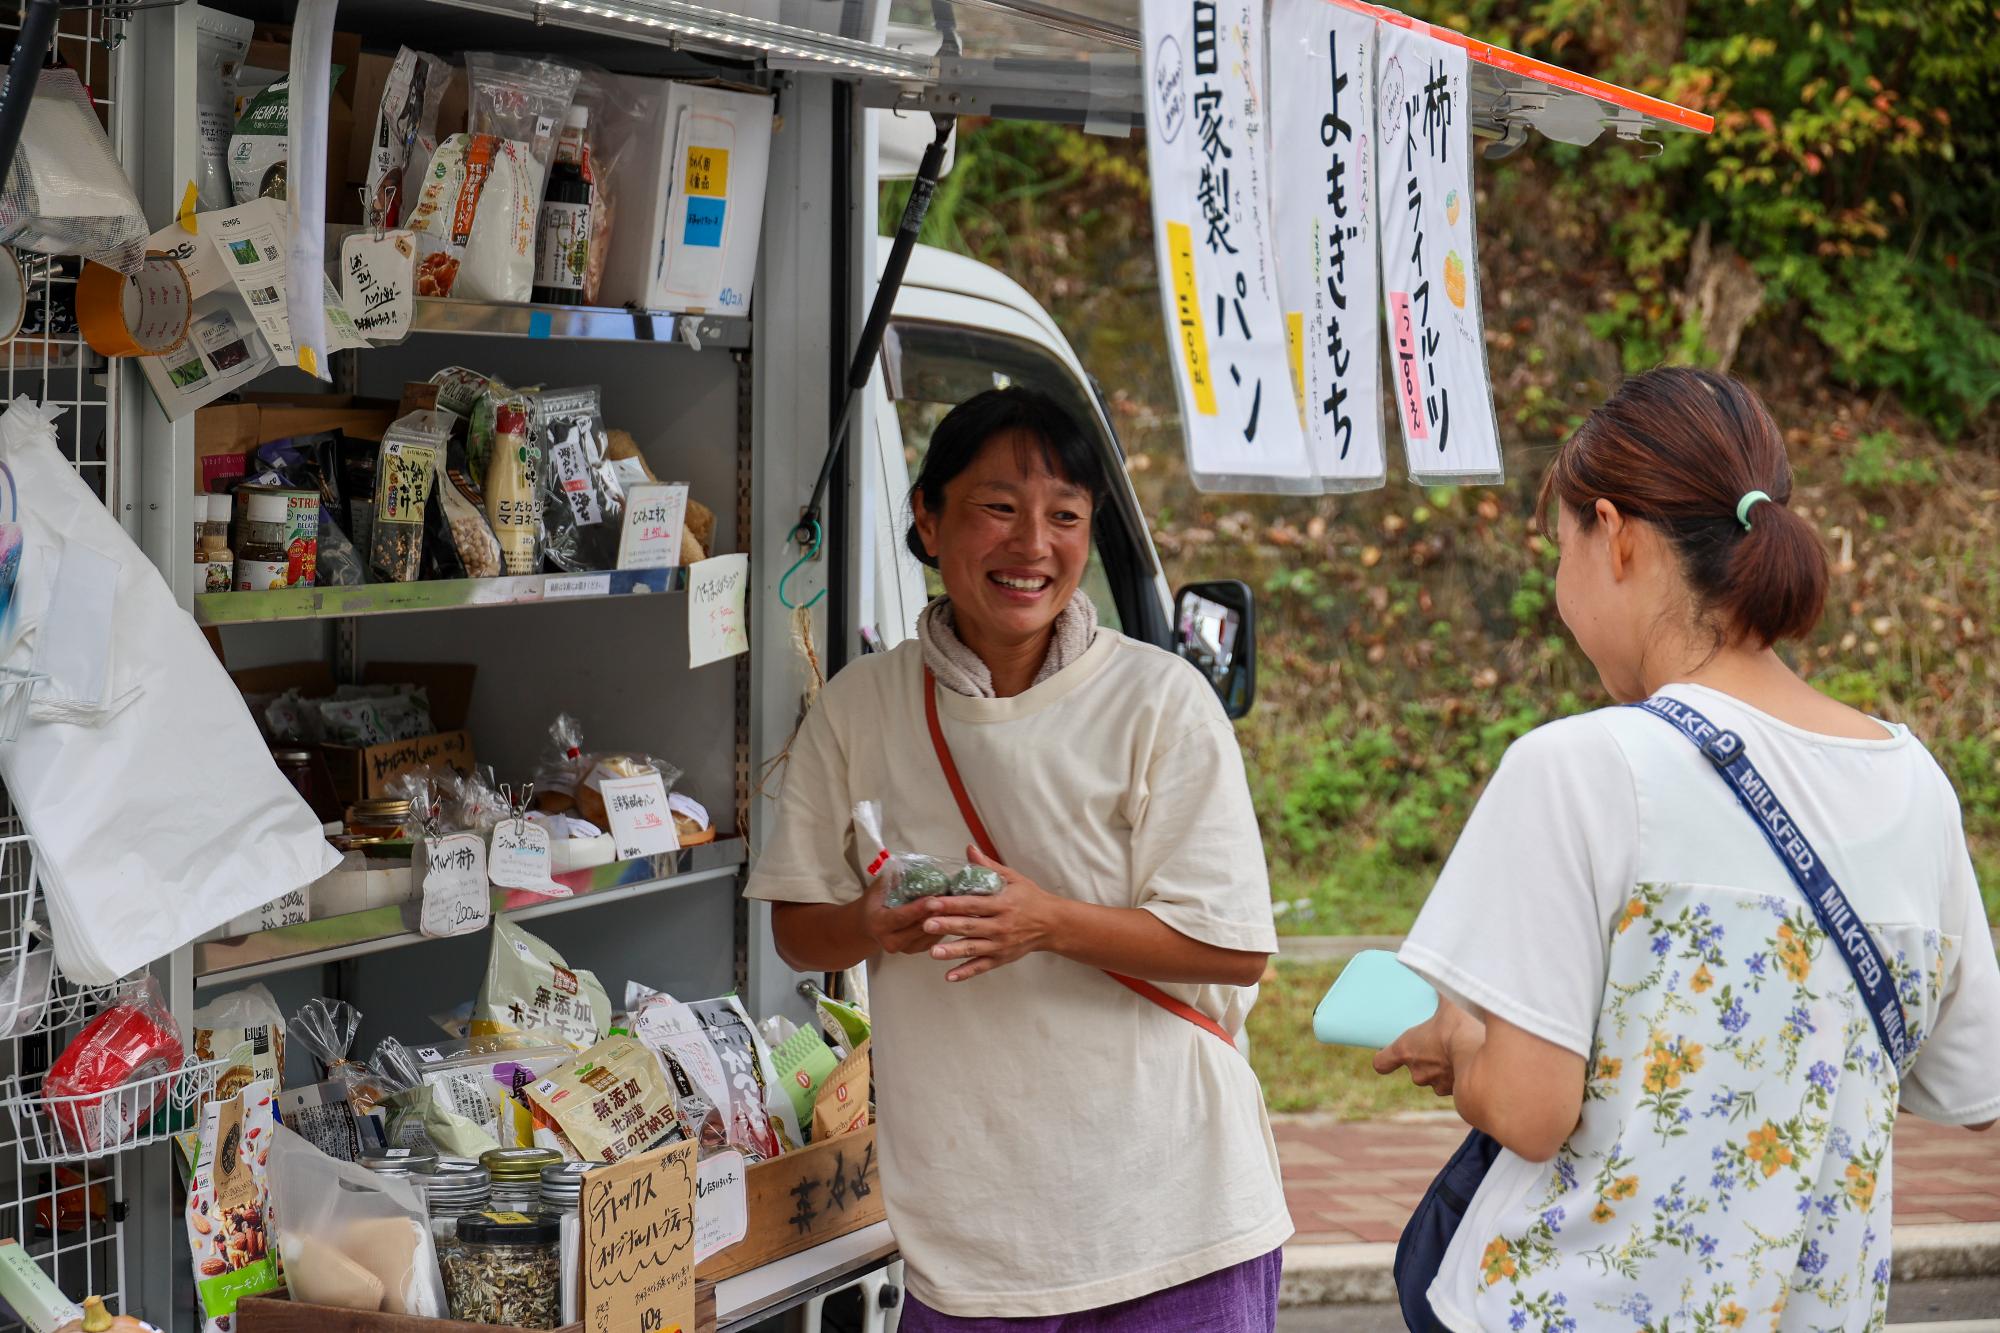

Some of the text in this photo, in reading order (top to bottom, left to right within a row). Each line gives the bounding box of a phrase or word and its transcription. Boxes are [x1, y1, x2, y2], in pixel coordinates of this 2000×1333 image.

[1424, 58, 1451, 163] 柿
[1321, 31, 1357, 459] よもぎもち
[1405, 94, 1449, 451] ドライフルーツ
[397, 456, 412, 518] ふりかけ
[410, 459, 425, 506] 納豆
[499, 513, 542, 526] マヨネー
[1645, 696, 1737, 756] MILKFD
[1739, 768, 1816, 880] MILKFED.
[1820, 885, 1884, 997] MILKFED.
[534, 984, 592, 1022] 無添加
[539, 1082, 552, 1093] 400
[592, 1077, 643, 1122] 無添加
[600, 1103, 675, 1165] 黒豆の甘納豆
[610, 1103, 646, 1135] 北海道
[593, 1172, 658, 1239] デトックス
